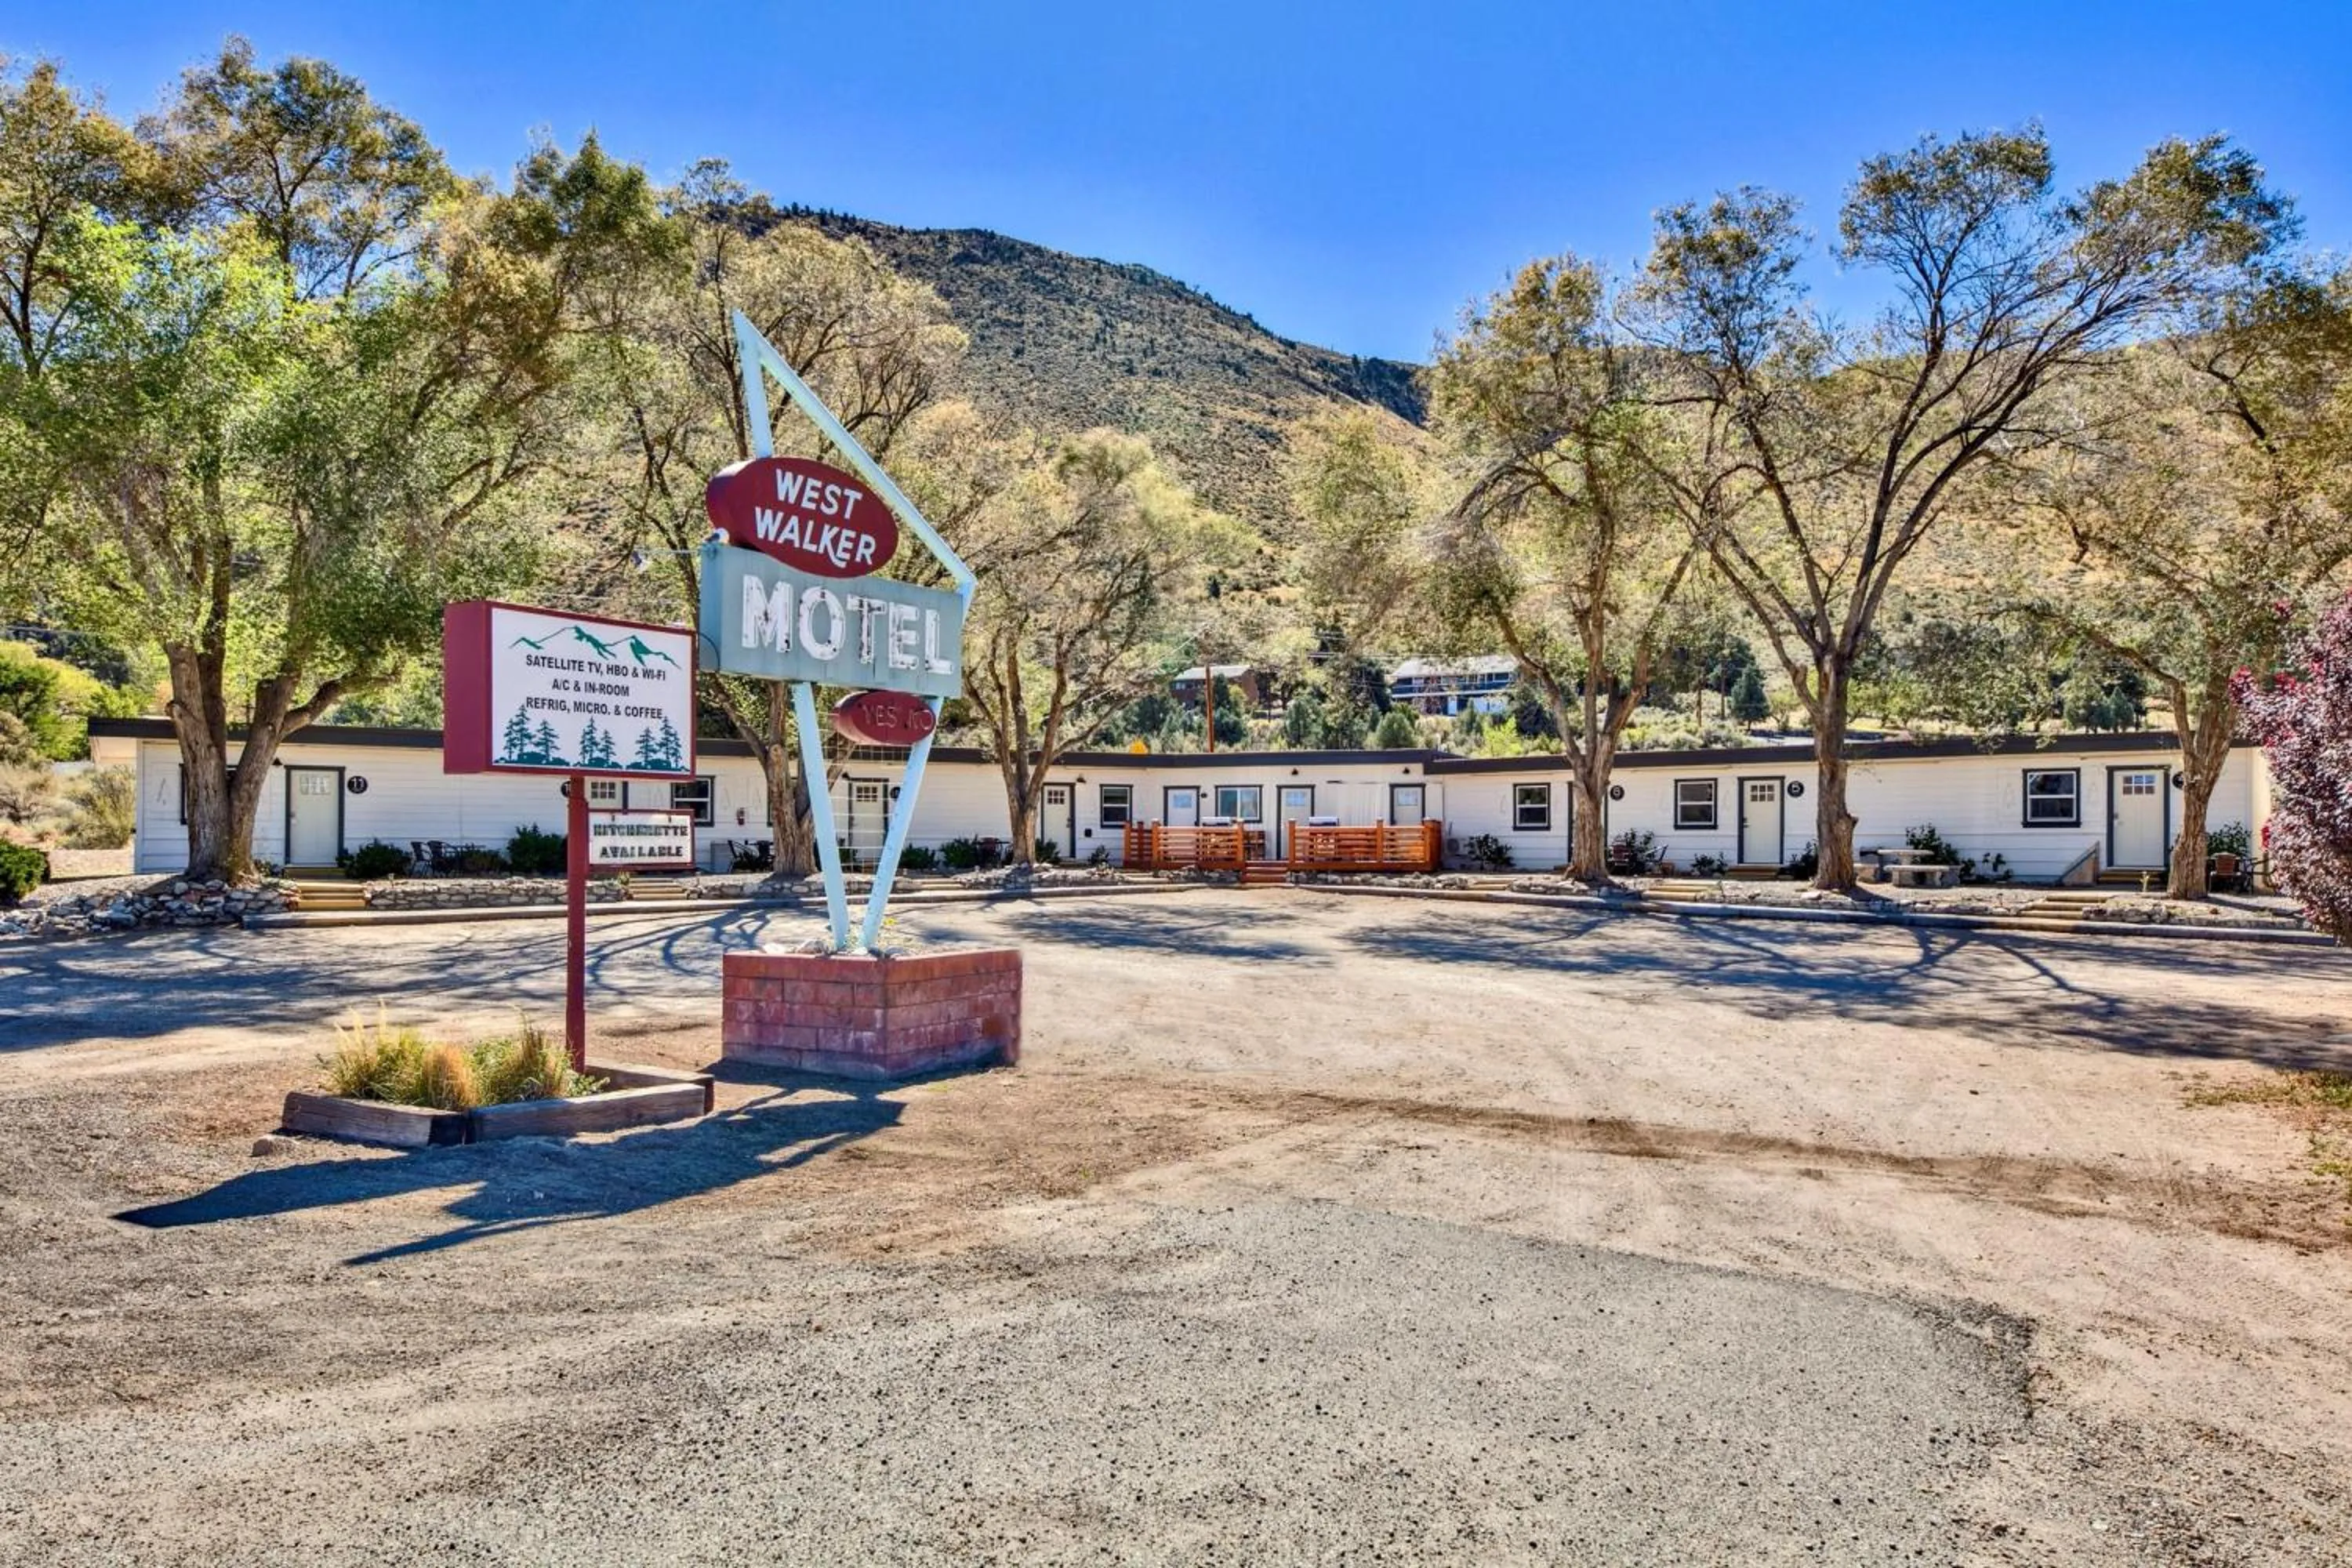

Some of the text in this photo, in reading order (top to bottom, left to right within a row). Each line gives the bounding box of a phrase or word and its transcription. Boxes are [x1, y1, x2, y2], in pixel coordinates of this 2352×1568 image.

[775, 468, 862, 520] WEST
[754, 506, 877, 568] WALKER
[742, 575, 953, 675] MOTEL
[526, 654, 666, 681] SATELLITE TV, HBO & WI-FI
[552, 679, 630, 696] A/C & IN-ROOM
[526, 696, 662, 719] REFRIG, MICRO. & COFFEE
[600, 846, 683, 858] AVAILABLE
